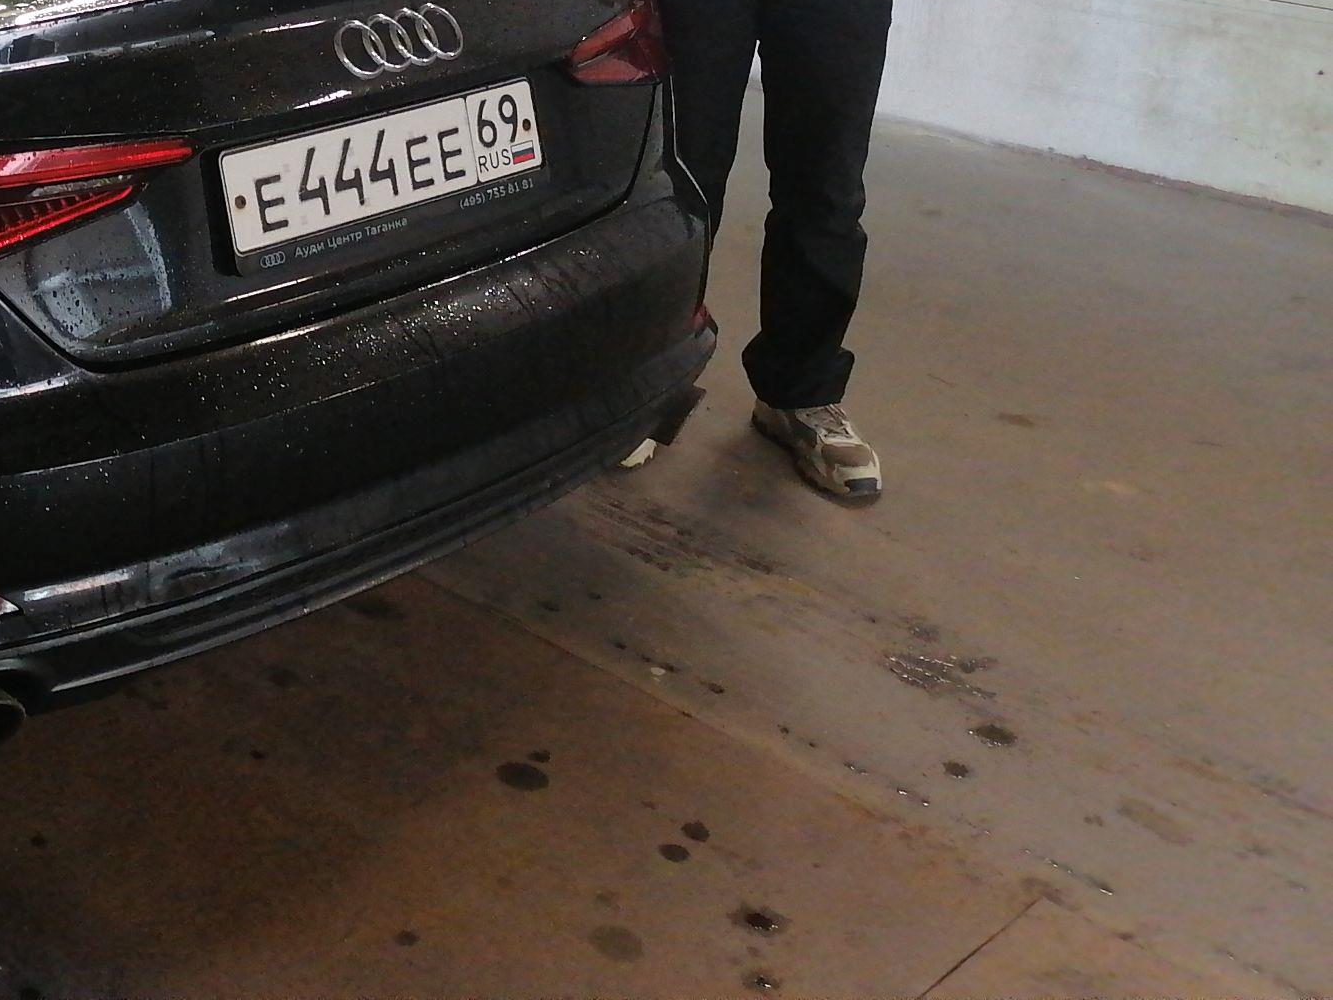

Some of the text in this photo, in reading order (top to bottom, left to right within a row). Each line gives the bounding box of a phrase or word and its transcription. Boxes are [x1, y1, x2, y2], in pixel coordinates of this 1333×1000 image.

[475, 93, 519, 148] 69
[478, 149, 512, 174] RUS
[459, 192, 486, 210] (495)
[293, 216, 409, 259] Ауди Центр Таганка
